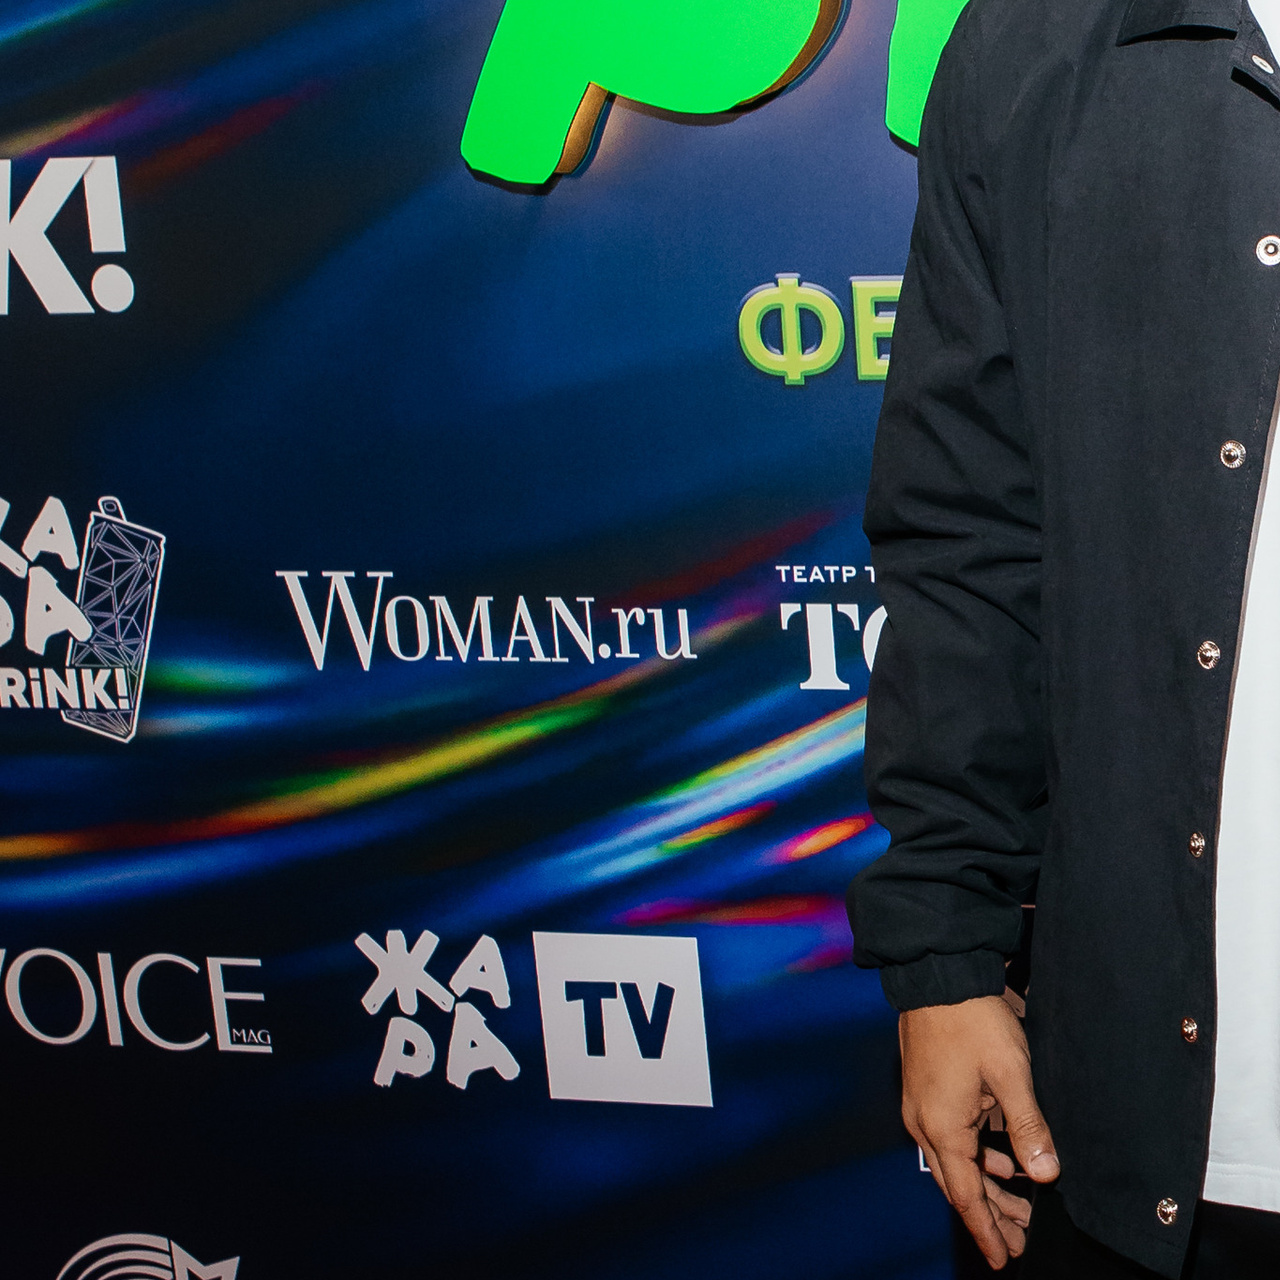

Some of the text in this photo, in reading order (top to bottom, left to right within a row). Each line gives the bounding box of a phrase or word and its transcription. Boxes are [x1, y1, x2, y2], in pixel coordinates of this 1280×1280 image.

[775, 565, 857, 583] ТЕАТР
[0, 947, 273, 1054] OICE
[564, 980, 676, 1060] TV
[232, 1027, 272, 1045] MAG
